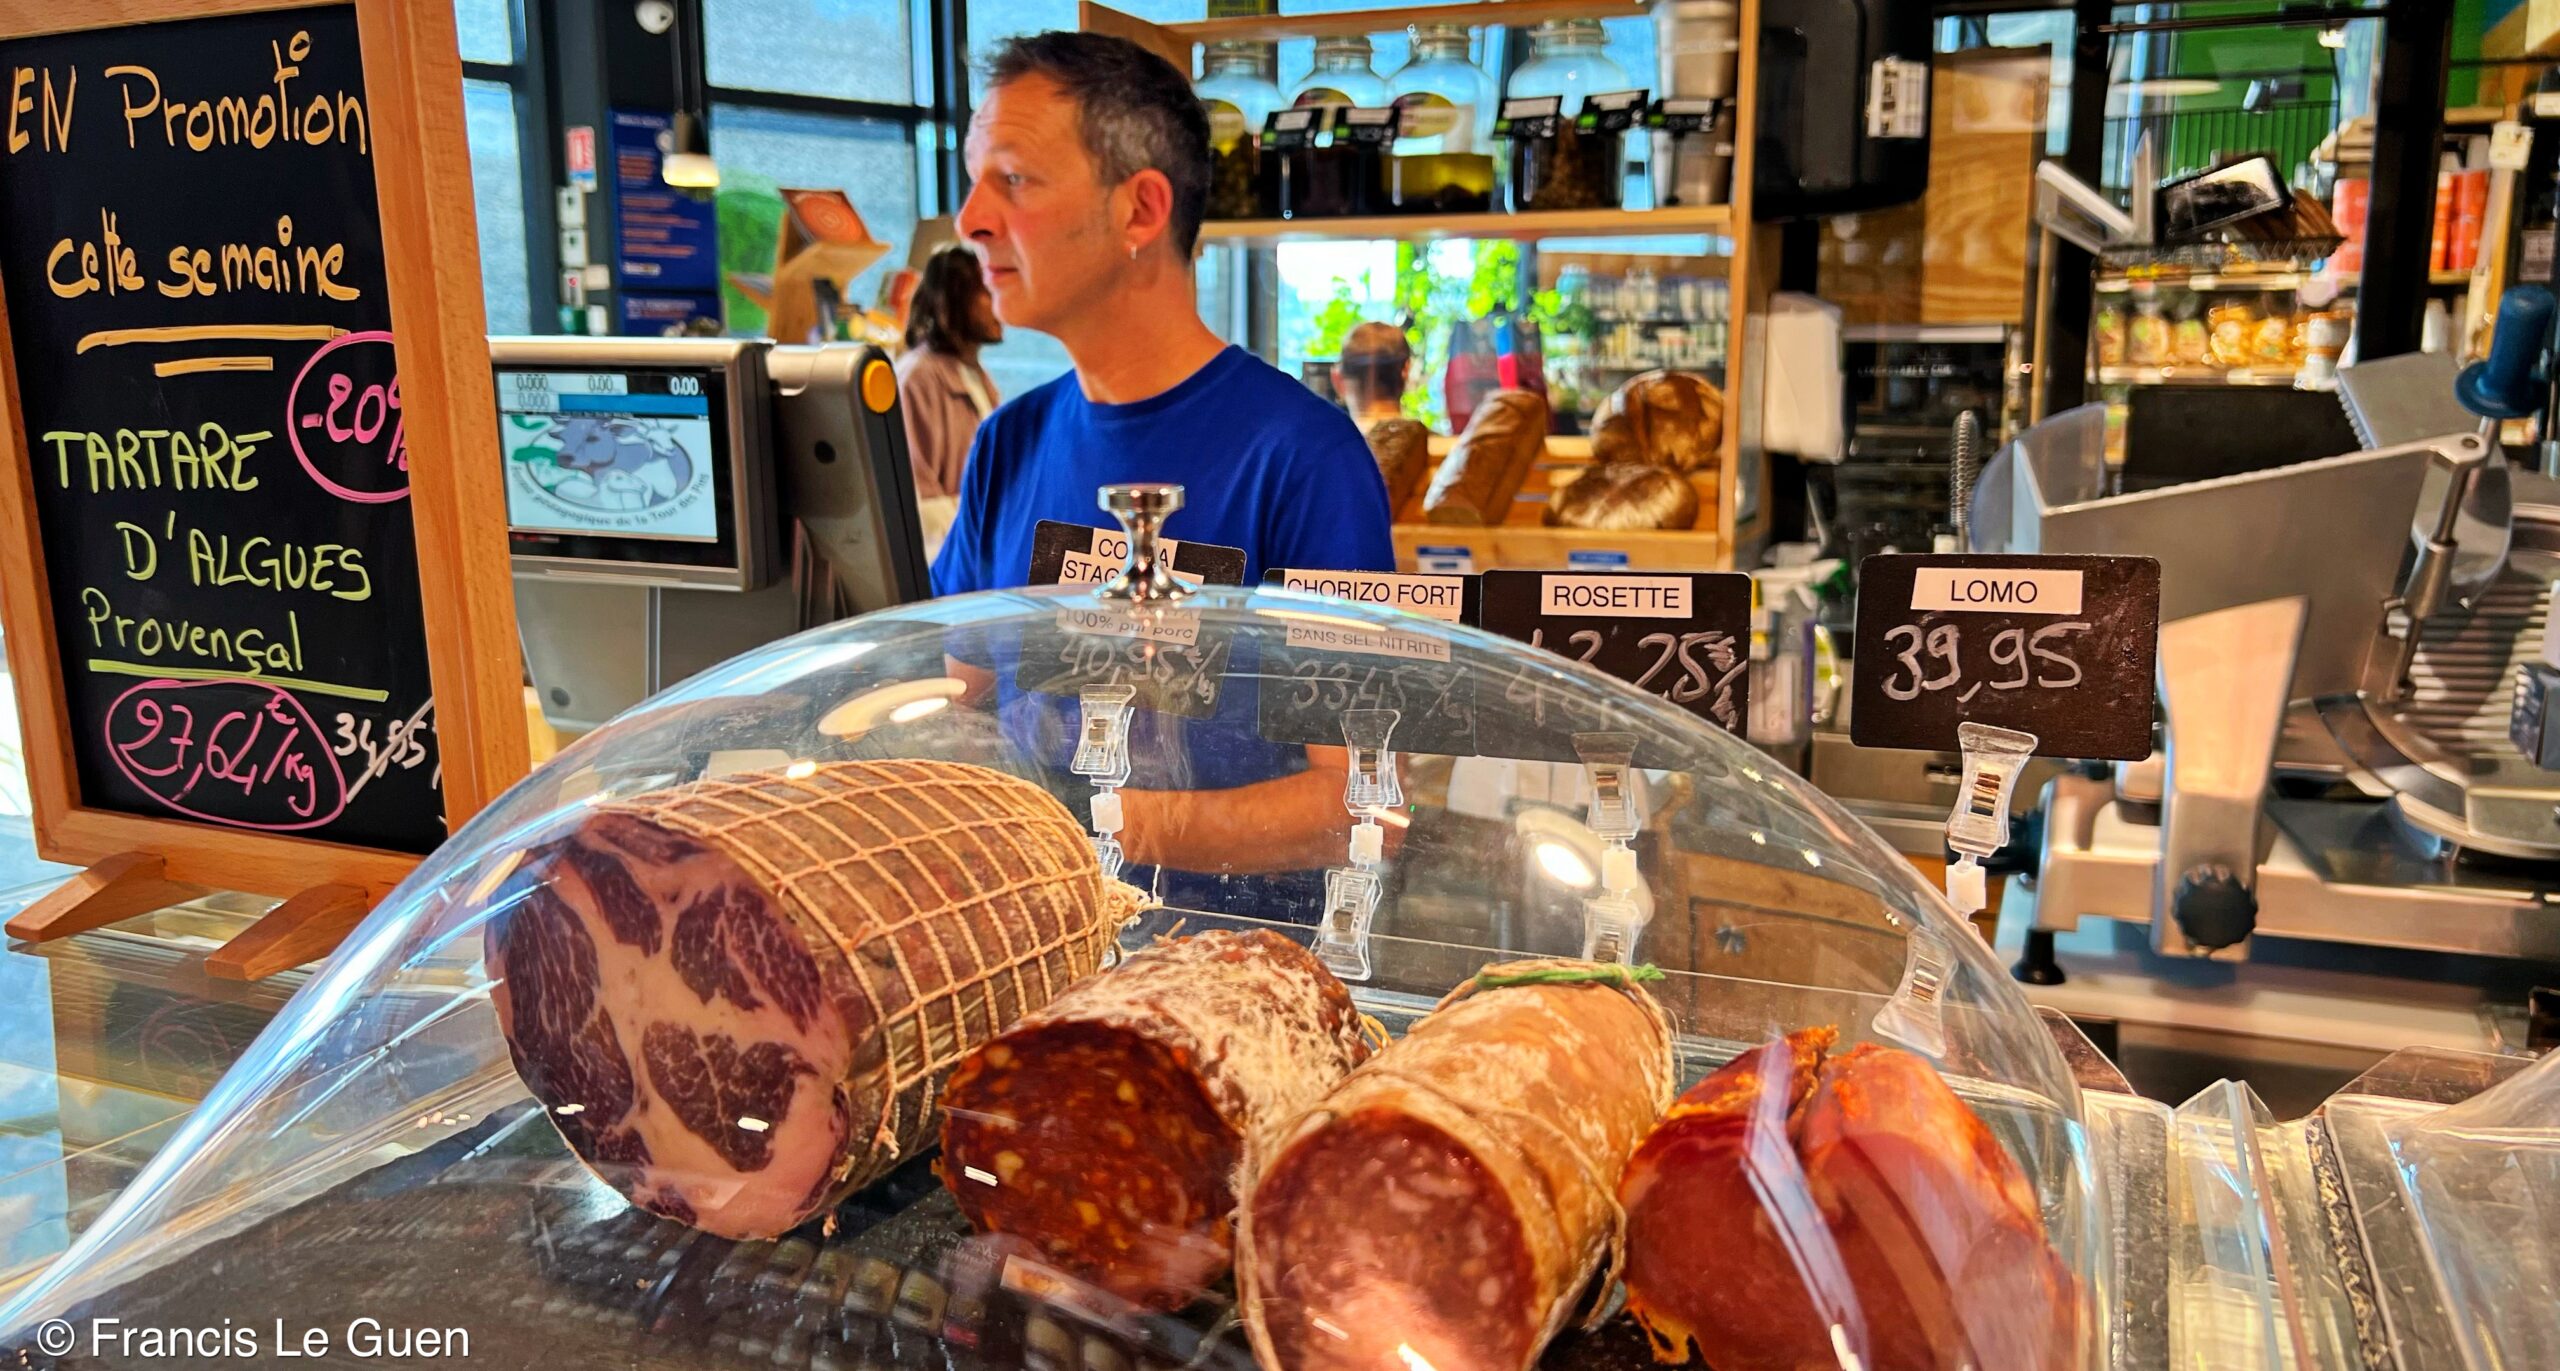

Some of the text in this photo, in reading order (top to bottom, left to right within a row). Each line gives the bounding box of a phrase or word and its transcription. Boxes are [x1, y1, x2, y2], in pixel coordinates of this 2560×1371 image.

[8, 31, 366, 155] EN Promotion
[158, 214, 360, 301] semaine
[43, 422, 273, 493] TARTARE
[115, 510, 372, 601] D'ALGUES
[1098, 538, 1169, 568] COA
[1287, 578, 1460, 606] CHORIZO FORT
[1553, 585, 1680, 609] ROSETTE
[1950, 580, 2038, 604] LOMO
[82, 587, 303, 677] Provençal
[1152, 627, 1194, 641] porc
[1291, 628, 1445, 657] SANS SEL NITRITE
[1880, 621, 2092, 704] 39,95
